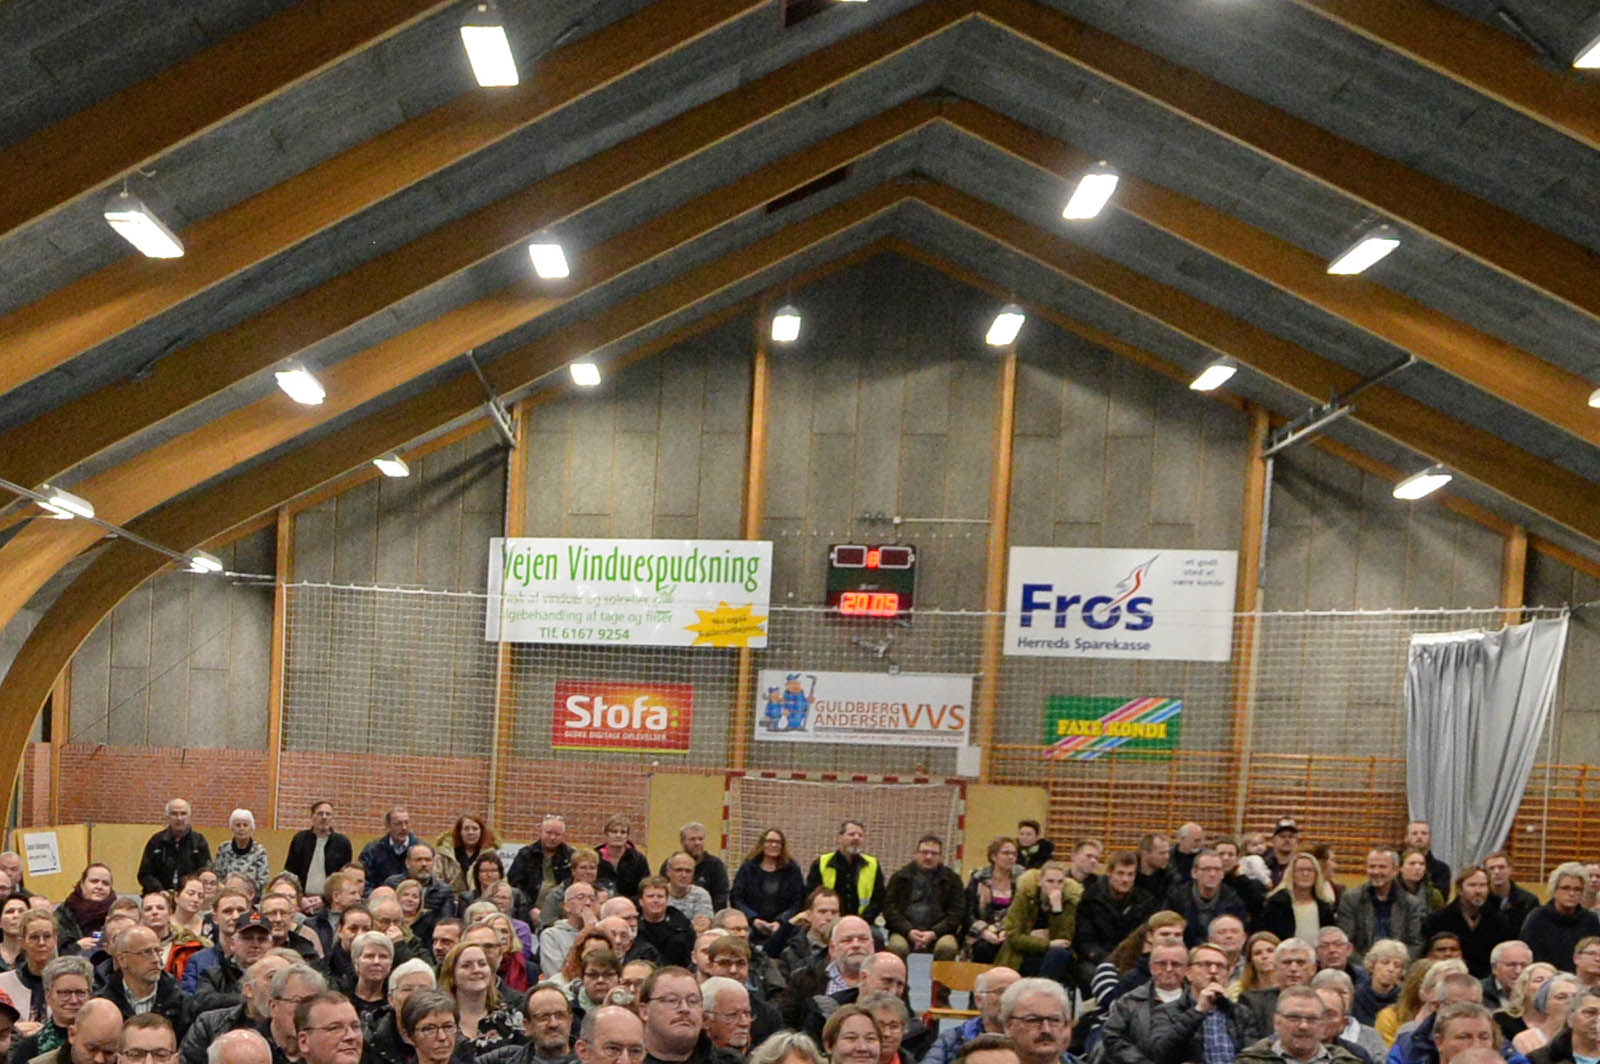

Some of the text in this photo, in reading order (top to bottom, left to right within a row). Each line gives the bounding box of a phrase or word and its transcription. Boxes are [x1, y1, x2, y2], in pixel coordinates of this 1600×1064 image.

[502, 544, 761, 593] Vejen Vinduespudsning
[504, 607, 583, 624] lgebehandling
[561, 627, 594, 640] 6167
[598, 628, 630, 641] 9254
[1017, 636, 1151, 652] Herreds Sparekasse
[815, 700, 901, 714] GULDBJERG
[814, 713, 900, 728] ANDERSEN
[901, 703, 965, 730] VVS
[1057, 719, 1168, 740] FAXE KONDI
